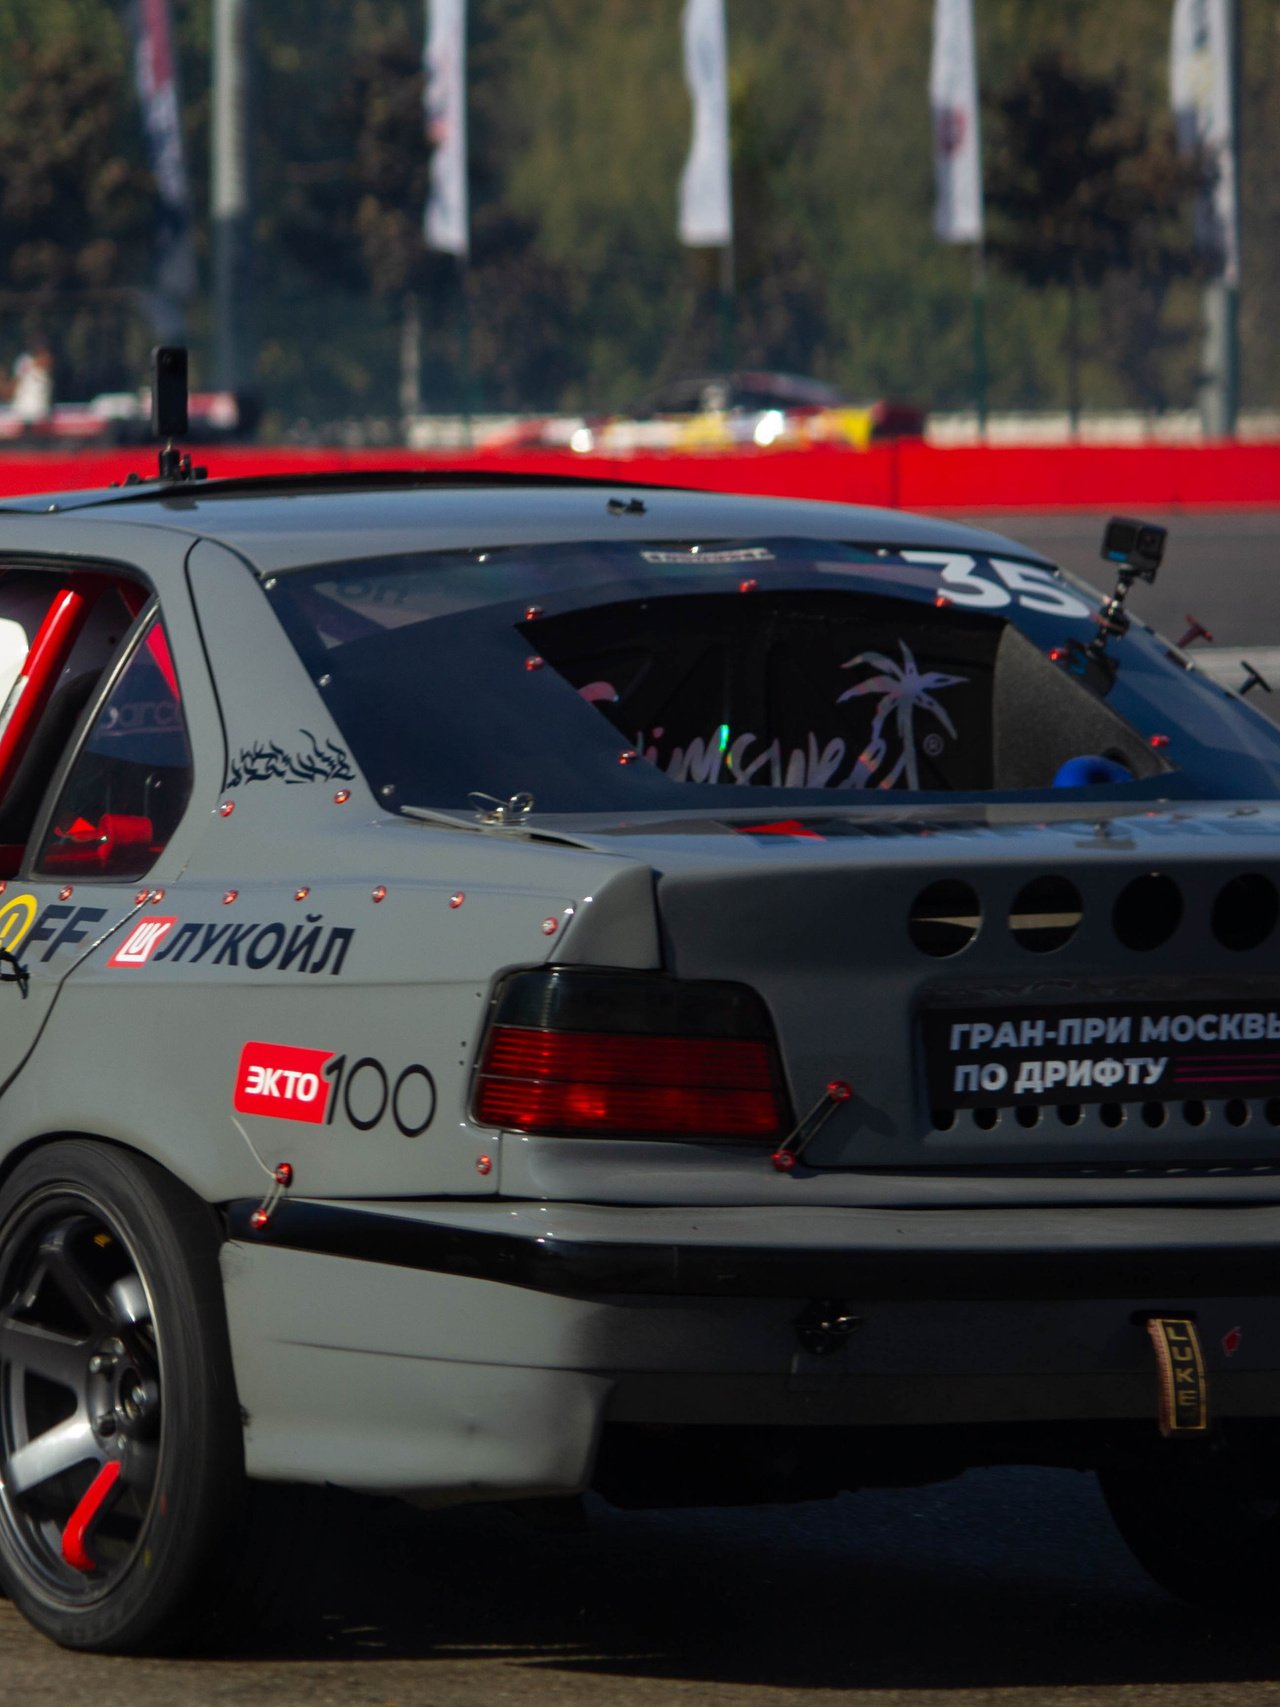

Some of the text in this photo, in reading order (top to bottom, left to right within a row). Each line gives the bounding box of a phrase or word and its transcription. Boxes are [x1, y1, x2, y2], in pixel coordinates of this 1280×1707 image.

[901, 551, 1090, 619] 35
[152, 913, 355, 975] ЛУКОЙЛ
[950, 1015, 1131, 1050] ГРАН-ПРИ
[244, 1054, 437, 1138] ЭКТО 100
[953, 1056, 1169, 1094] ПО ДРИФТУ
[1165, 1326, 1198, 1406] LUKE
